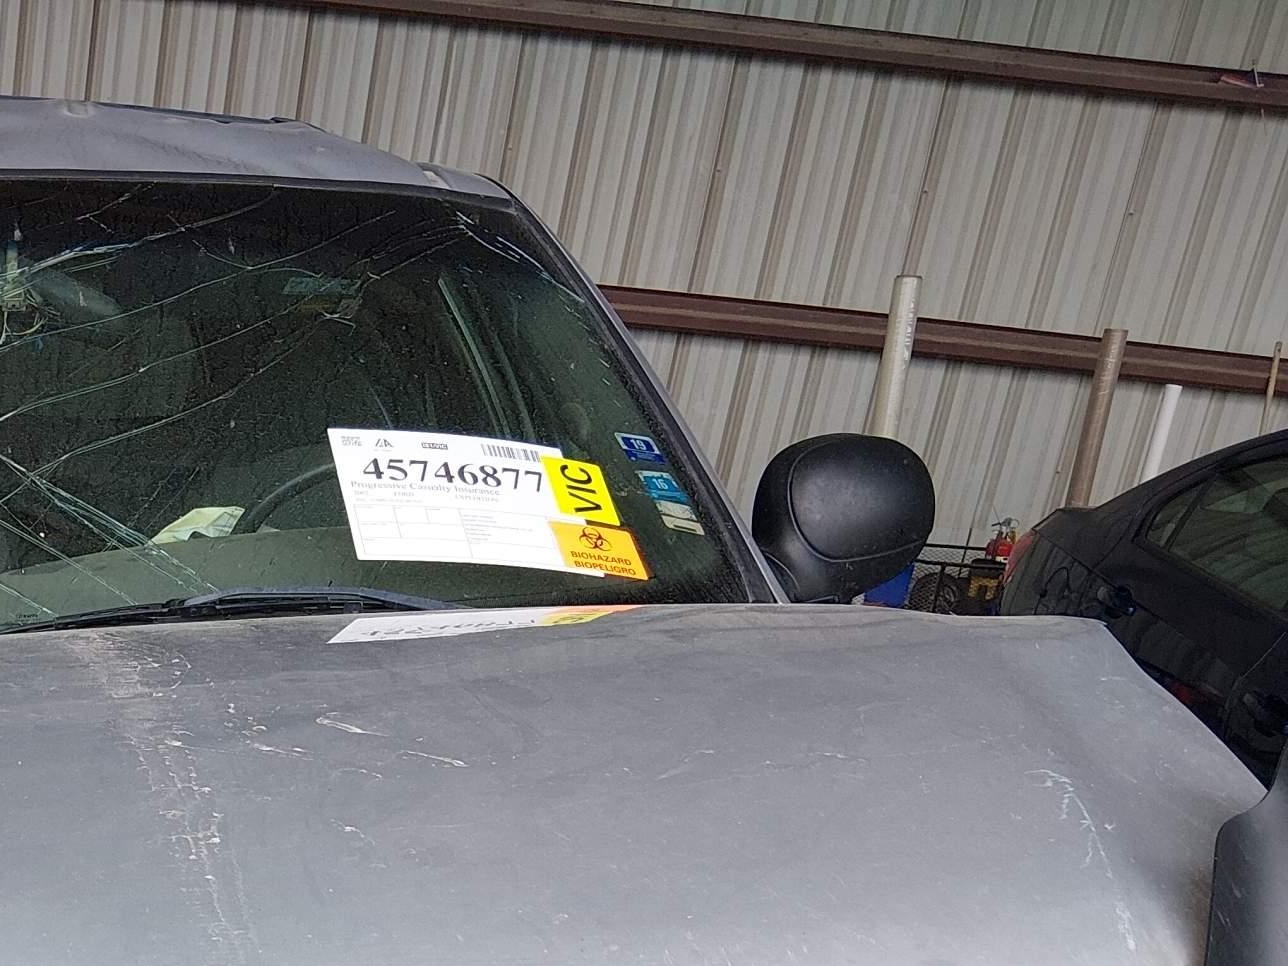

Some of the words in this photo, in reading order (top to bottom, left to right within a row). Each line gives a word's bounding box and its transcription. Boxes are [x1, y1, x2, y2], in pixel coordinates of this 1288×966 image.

[630, 439, 647, 451] 19
[363, 457, 542, 493] 45746877
[559, 464, 603, 513] VIC
[570, 550, 632, 566] BIOHAZARD
[574, 560, 637, 576] BIOPELIGRO
